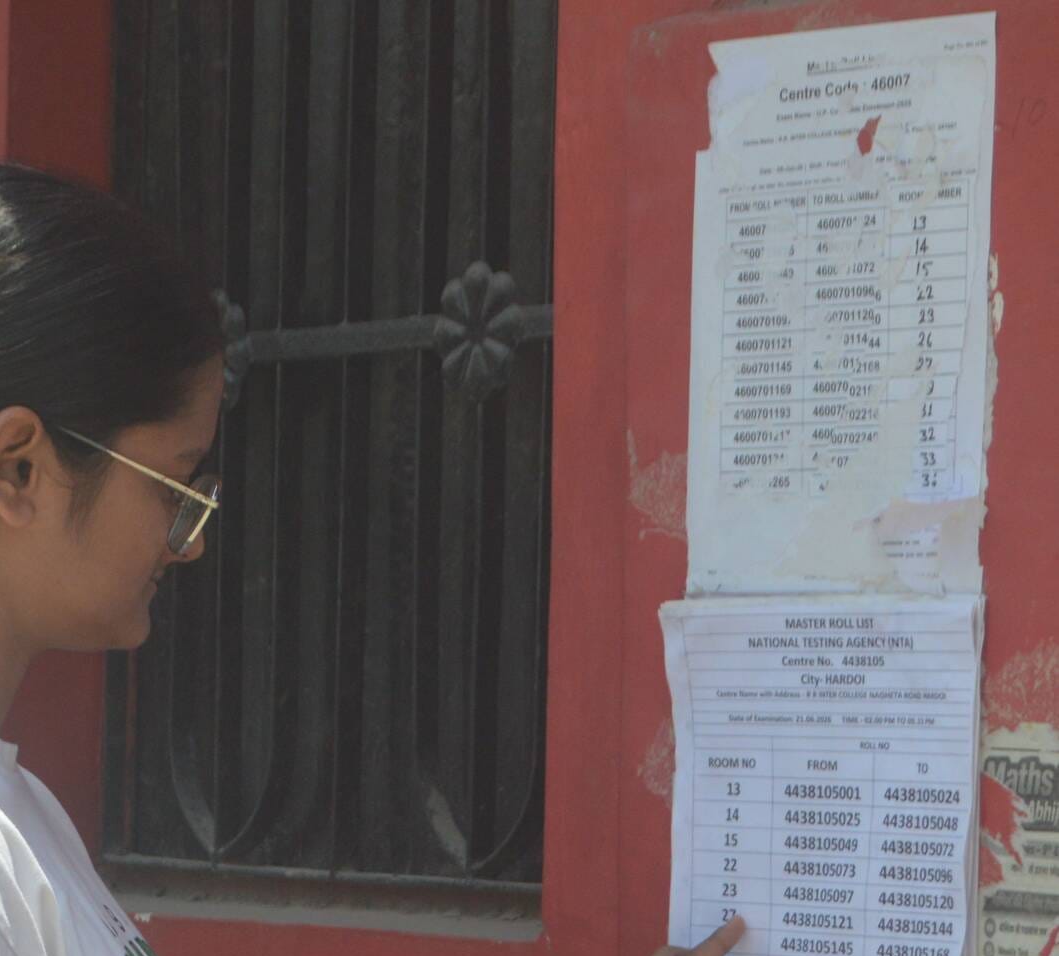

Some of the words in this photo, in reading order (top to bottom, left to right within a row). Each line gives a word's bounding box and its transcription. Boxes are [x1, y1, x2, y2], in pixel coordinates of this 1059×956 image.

[779, 82, 821, 103] Centre
[934, 187, 962, 200] MBER
[912, 215, 927, 231] 13
[915, 237, 929, 255] 14
[916, 260, 933, 277] 15
[736, 314, 791, 328] 460070109
[918, 308, 935, 324] 23
[737, 361, 792, 376] 600701145
[785, 618, 826, 629] MASTER
[829, 618, 853, 629] ROLL
[856, 618, 874, 629] LIST
[748, 637, 800, 649] NATIONAL
[803, 637, 843, 648] TESTING
[782, 656, 814, 667] Centre
[817, 656, 834, 667] No.
[842, 656, 885, 667] 4438105
[825, 674, 865, 685] HARDOI
[860, 741, 876, 750] ROLL
[877, 742, 890, 750] NO
[708, 757, 739, 768] ROOM
[742, 758, 756, 769] NO
[807, 759, 838, 771] FROM
[917, 763, 929, 774] TO
[726, 782, 741, 797] 13
[784, 784, 861, 800] 4438105001
[884, 788, 960, 804] 4438105024
[725, 808, 739, 822] 14
[784, 811, 861, 827] 4438105025
[883, 814, 959, 831] 4438105048
[724, 833, 738, 847] 15
[784, 836, 859, 852] 4438105049
[881, 840, 955, 857] 4438105072
[723, 858, 737, 872] 22
[783, 861, 856, 878] 4438105073
[722, 883, 737, 897] 23
[783, 886, 854, 904] 4438105097
[878, 892, 954, 910] 4438105120
[722, 909, 737, 922] 27
[782, 912, 853, 930] 4438105121
[877, 918, 953, 936] 4438105144
[780, 937, 853, 955] 4438105145
